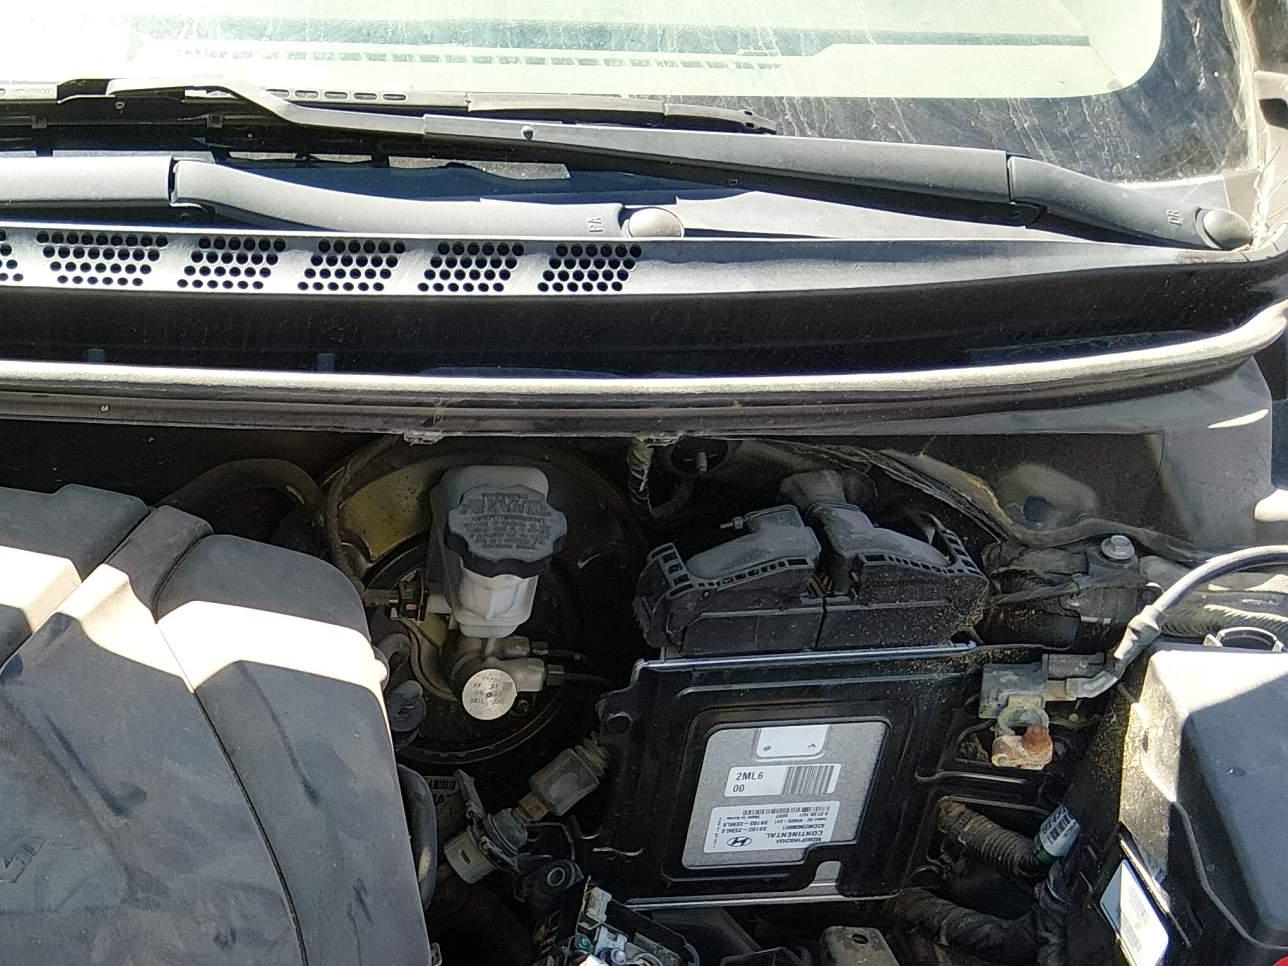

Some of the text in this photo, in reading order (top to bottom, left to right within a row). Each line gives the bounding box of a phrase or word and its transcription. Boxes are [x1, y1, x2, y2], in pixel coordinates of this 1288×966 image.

[736, 771, 764, 781] 2ML6
[732, 784, 745, 793] 00
[766, 830, 824, 839] CONTINENTAL
